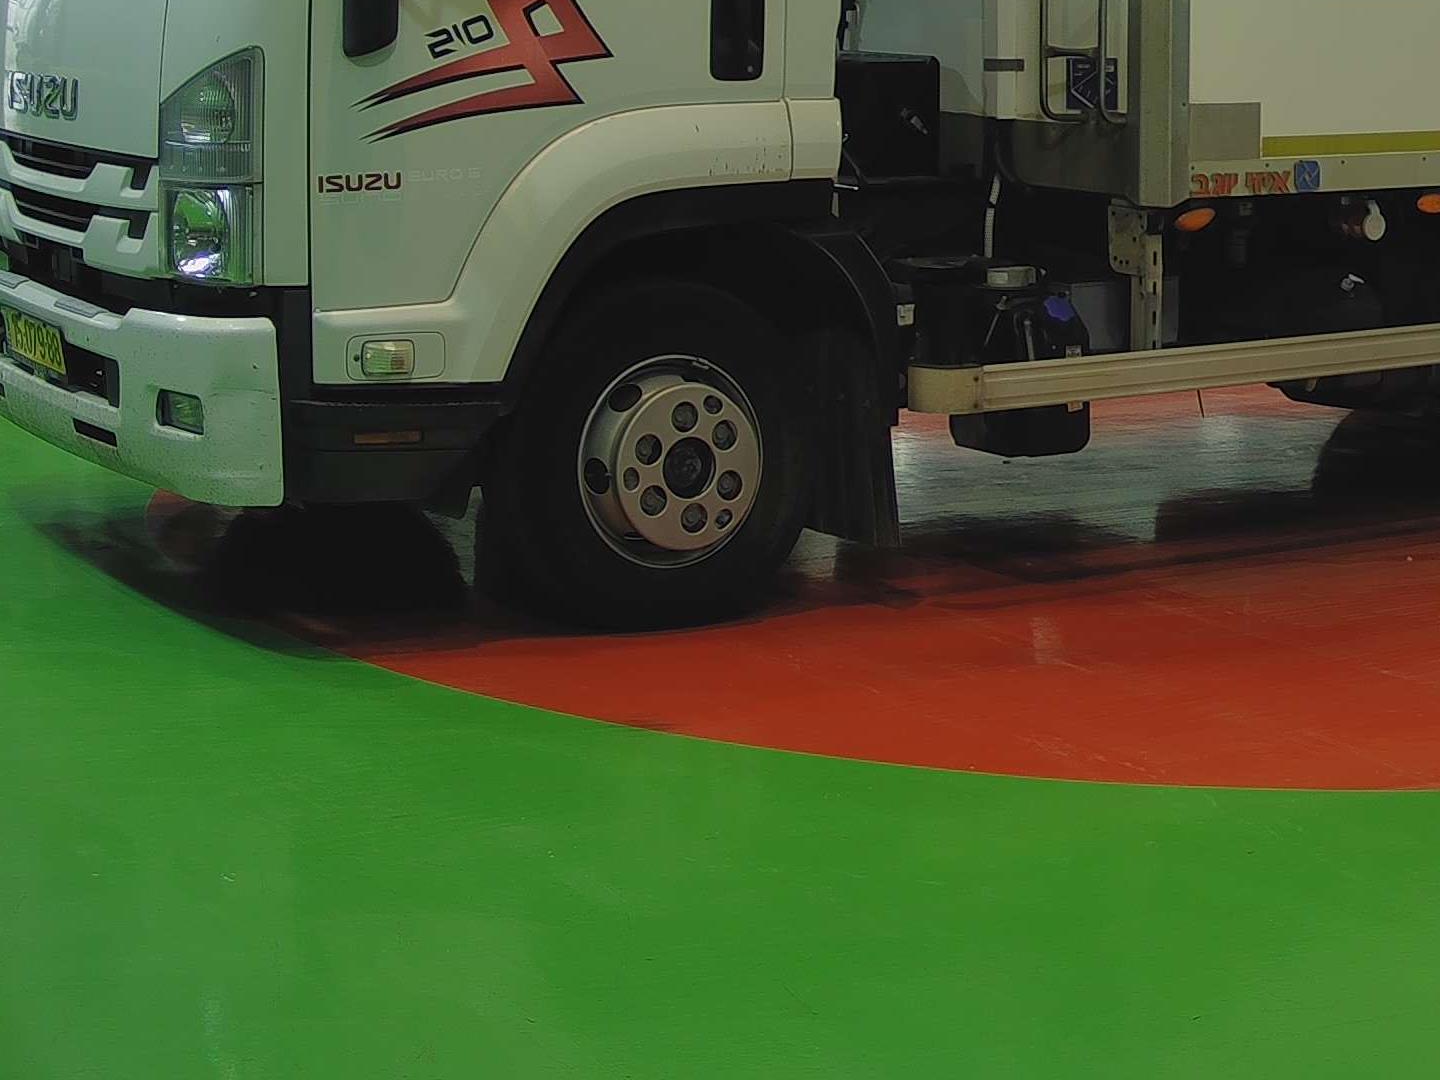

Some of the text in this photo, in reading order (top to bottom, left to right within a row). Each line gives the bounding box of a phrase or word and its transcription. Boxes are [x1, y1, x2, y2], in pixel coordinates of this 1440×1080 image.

[424, 14, 494, 59] 210
[8, 70, 79, 121] ISUZU
[317, 171, 402, 193] ISUZU
